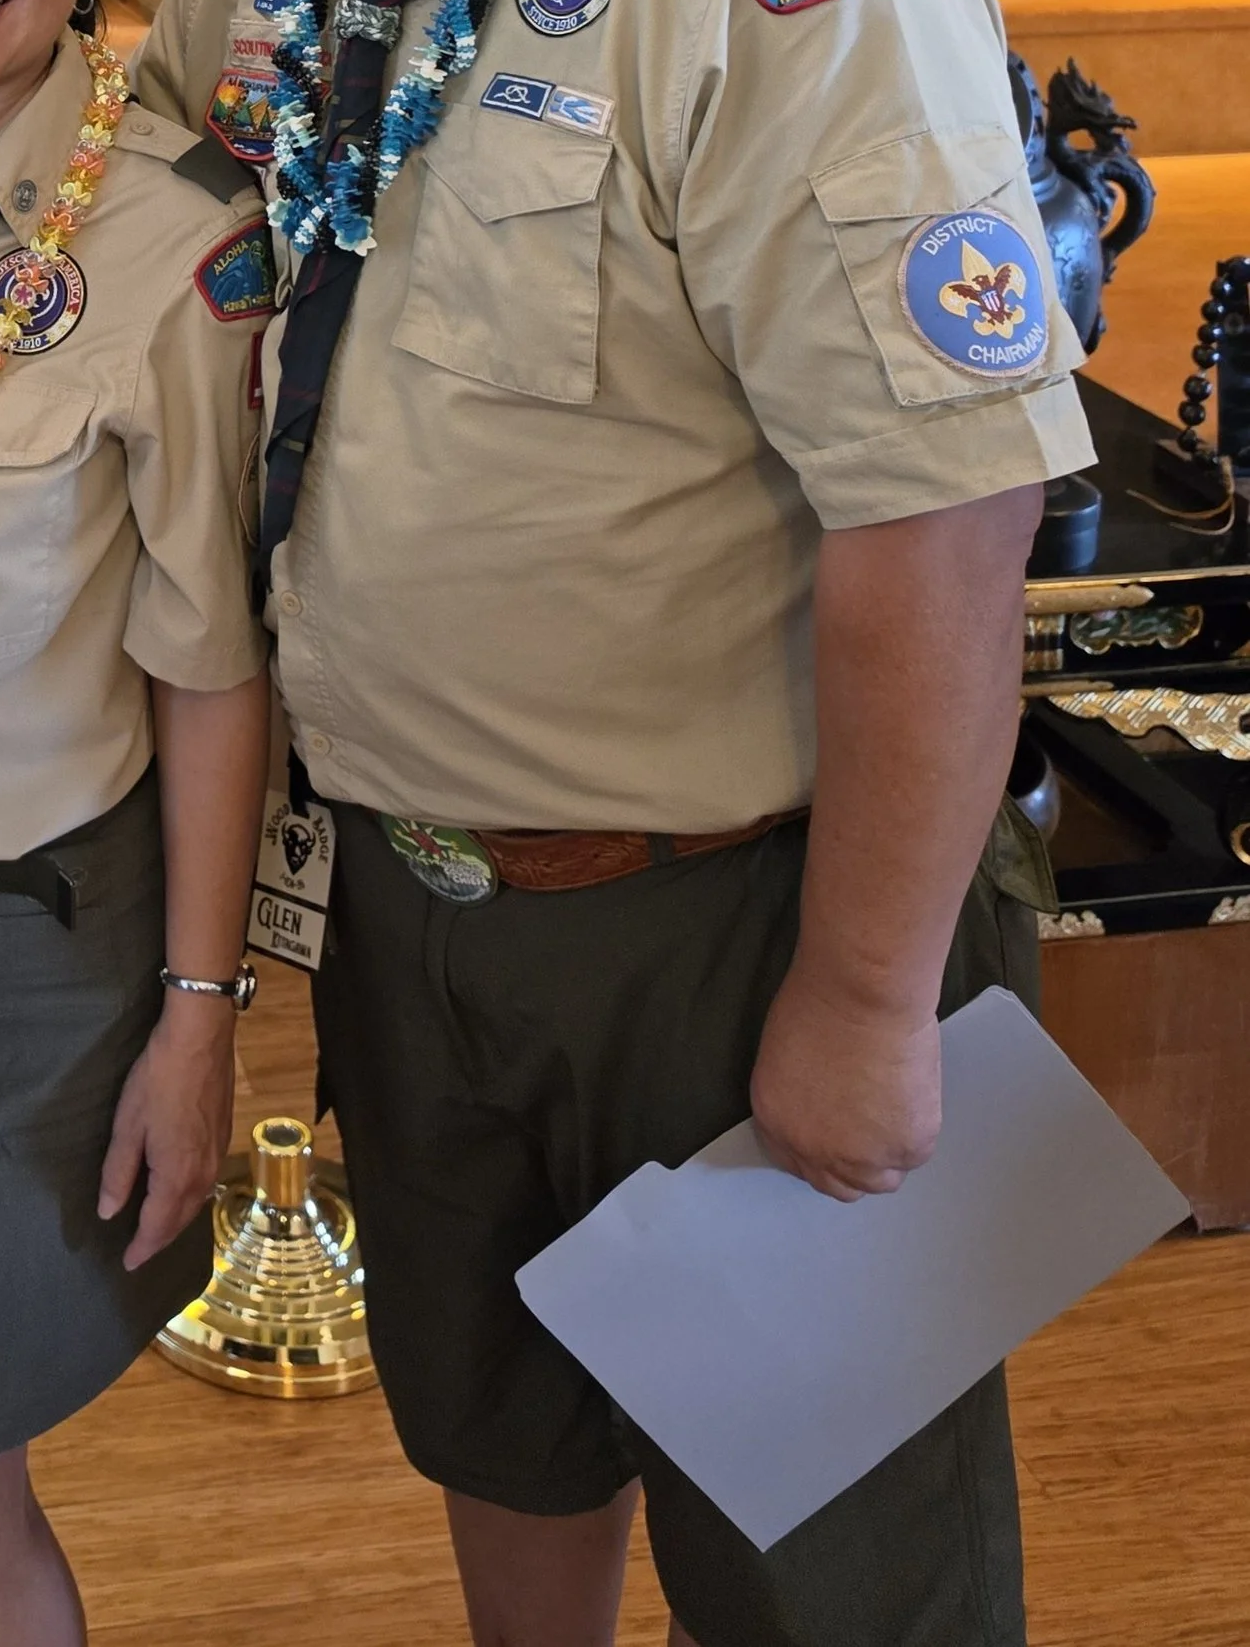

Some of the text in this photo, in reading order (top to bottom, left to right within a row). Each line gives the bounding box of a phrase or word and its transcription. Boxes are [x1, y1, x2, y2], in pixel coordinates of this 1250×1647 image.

[528, 6, 578, 31] SINCE 1910
[921, 216, 998, 256] DISTRICT
[213, 239, 249, 275] ALOHA
[59, 259, 81, 305] AMERICA
[19, 337, 41, 348] 1910
[968, 322, 1045, 364] CHAIRMAN
[265, 804, 290, 846] WOOD
[312, 816, 329, 864] BADGE
[257, 897, 303, 936] GLEN
